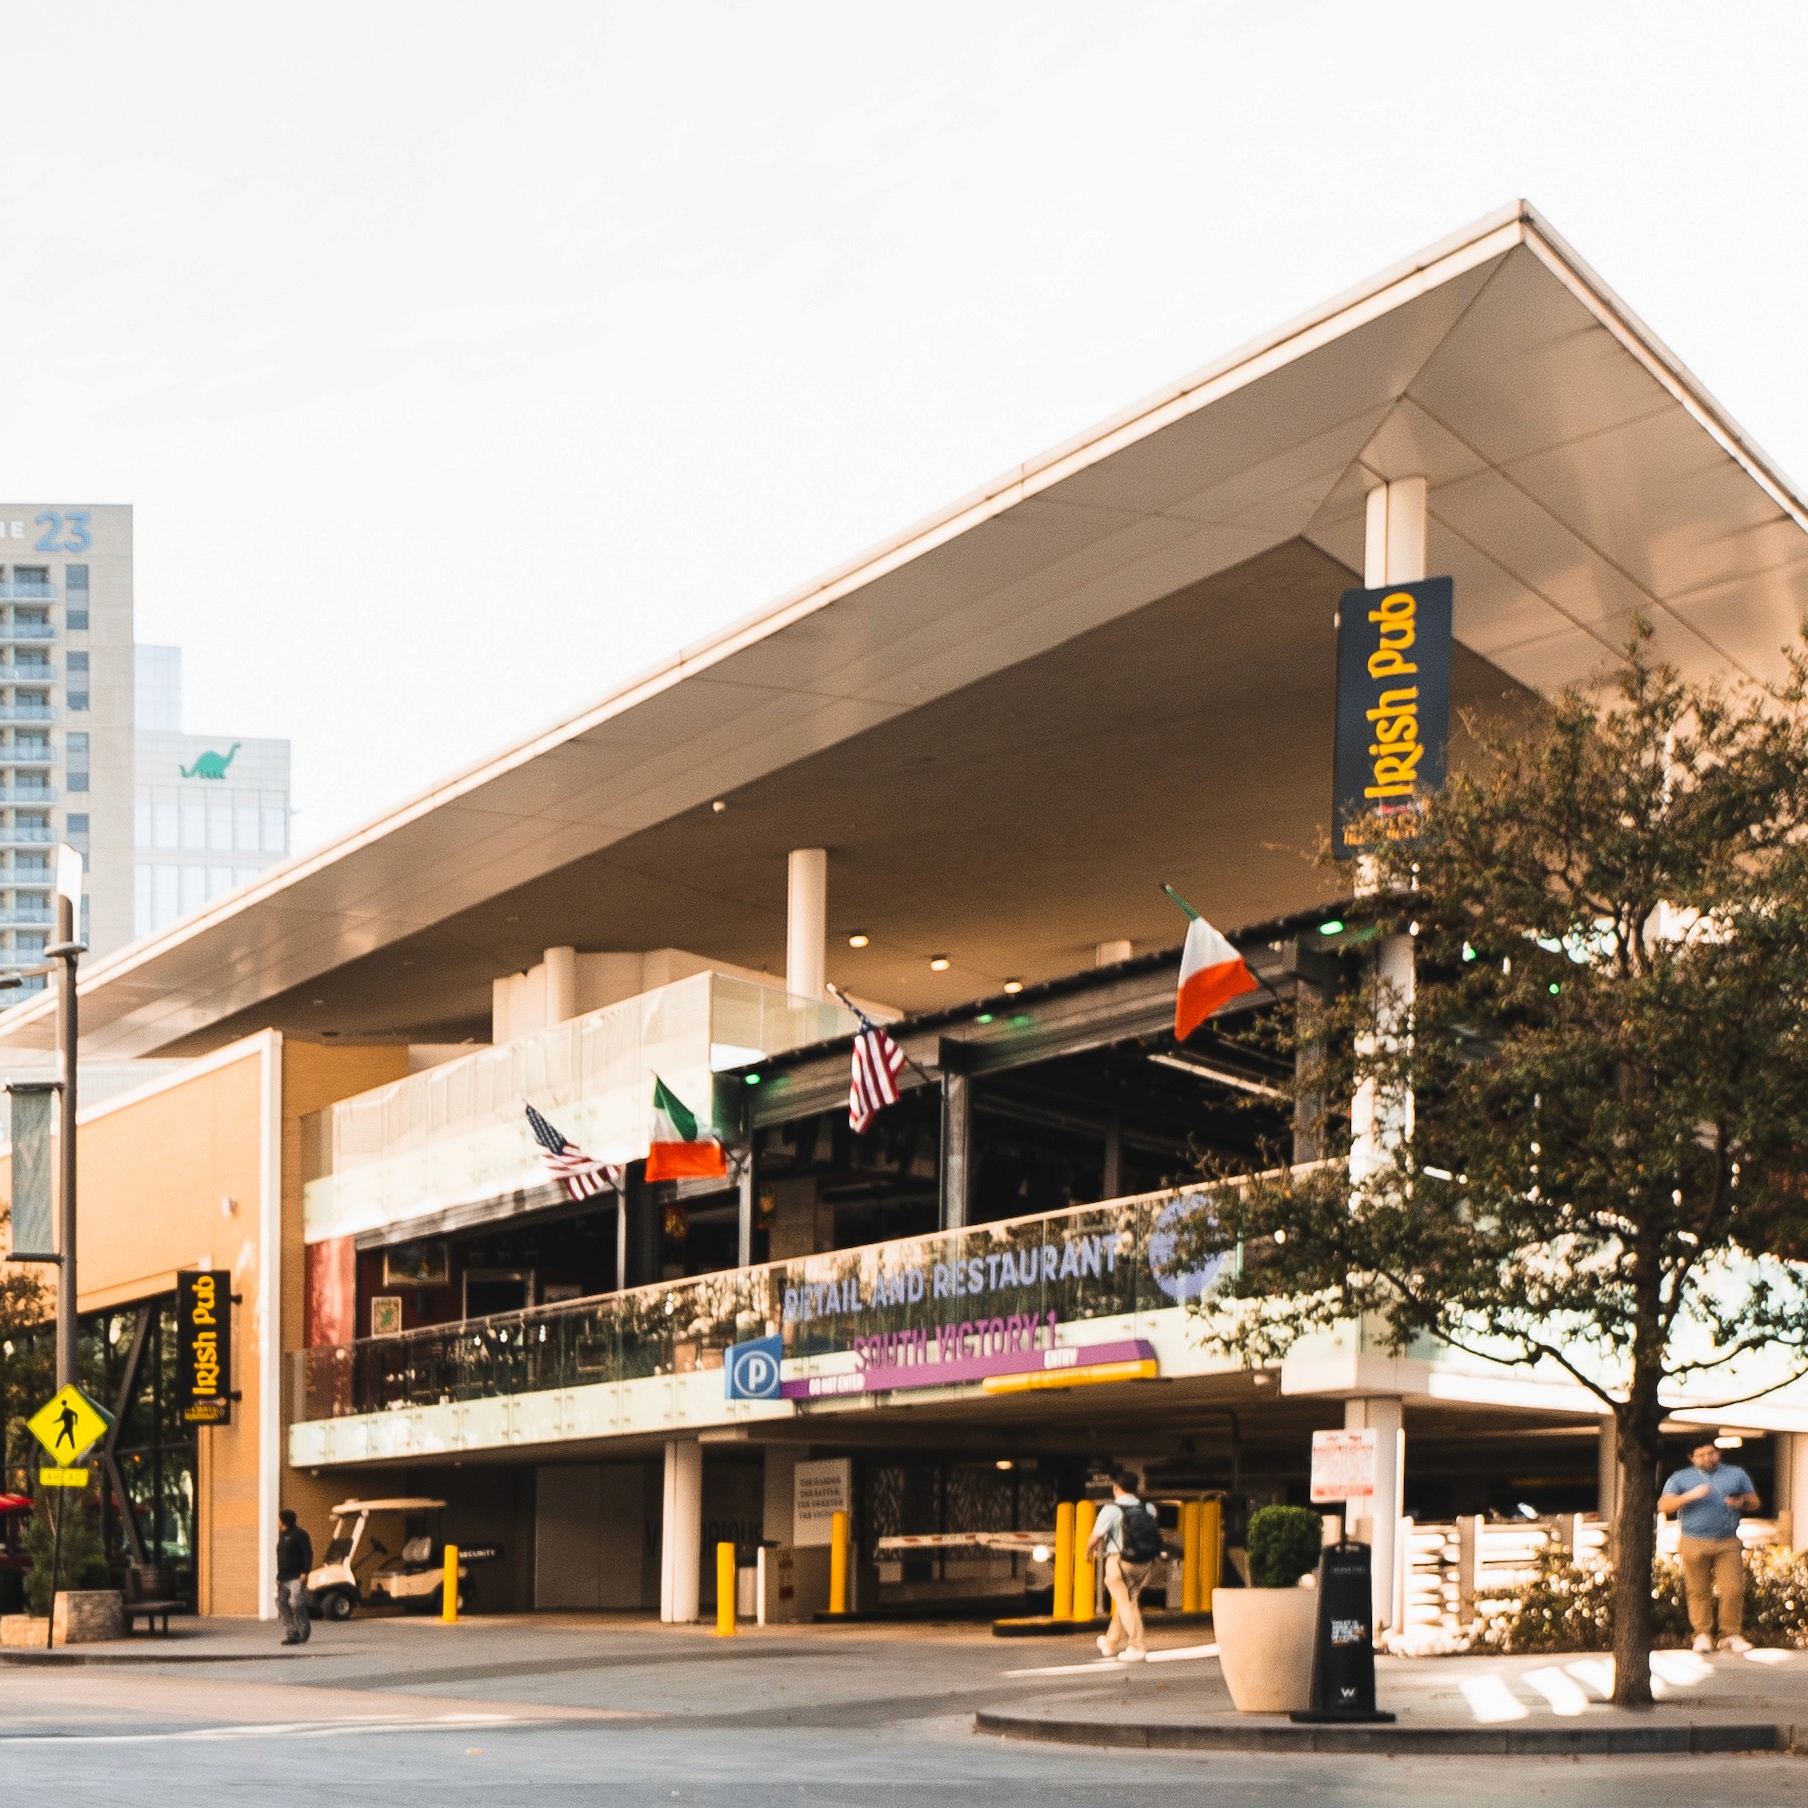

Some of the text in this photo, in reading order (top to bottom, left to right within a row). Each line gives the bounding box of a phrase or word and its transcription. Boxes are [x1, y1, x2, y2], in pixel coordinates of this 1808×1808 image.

[34, 511, 93, 553] 23
[783, 1235, 1121, 1322] RETAIL AND RESTAURANT
[854, 1327, 927, 1371] SOUTH
[936, 1312, 1040, 1362] VICTORY
[748, 1358, 767, 1391] P
[1341, 1688, 1355, 1697] W
